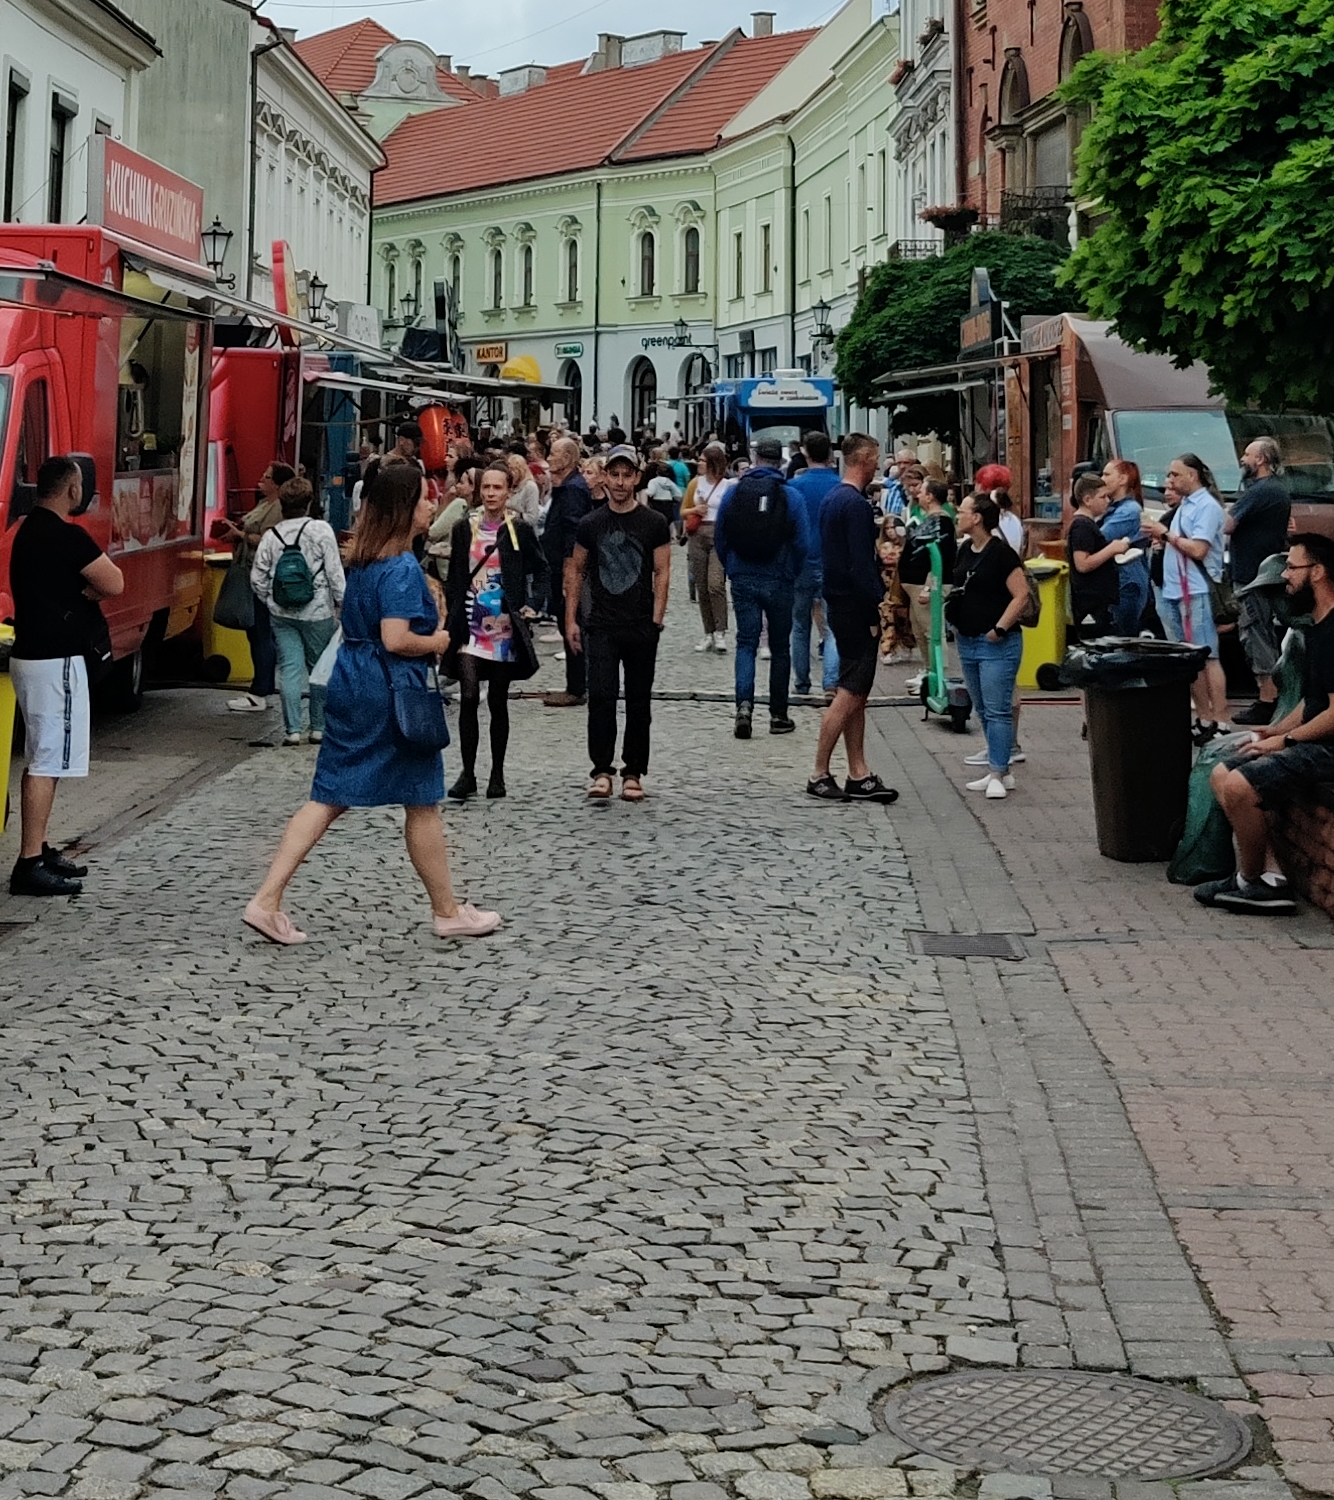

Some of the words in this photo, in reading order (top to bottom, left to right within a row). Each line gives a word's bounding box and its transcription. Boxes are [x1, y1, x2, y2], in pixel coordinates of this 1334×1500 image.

[110, 159, 152, 228] KUCHNIA
[152, 183, 197, 245] GRUZIŃSKA
[476, 345, 504, 360] KANTOR
